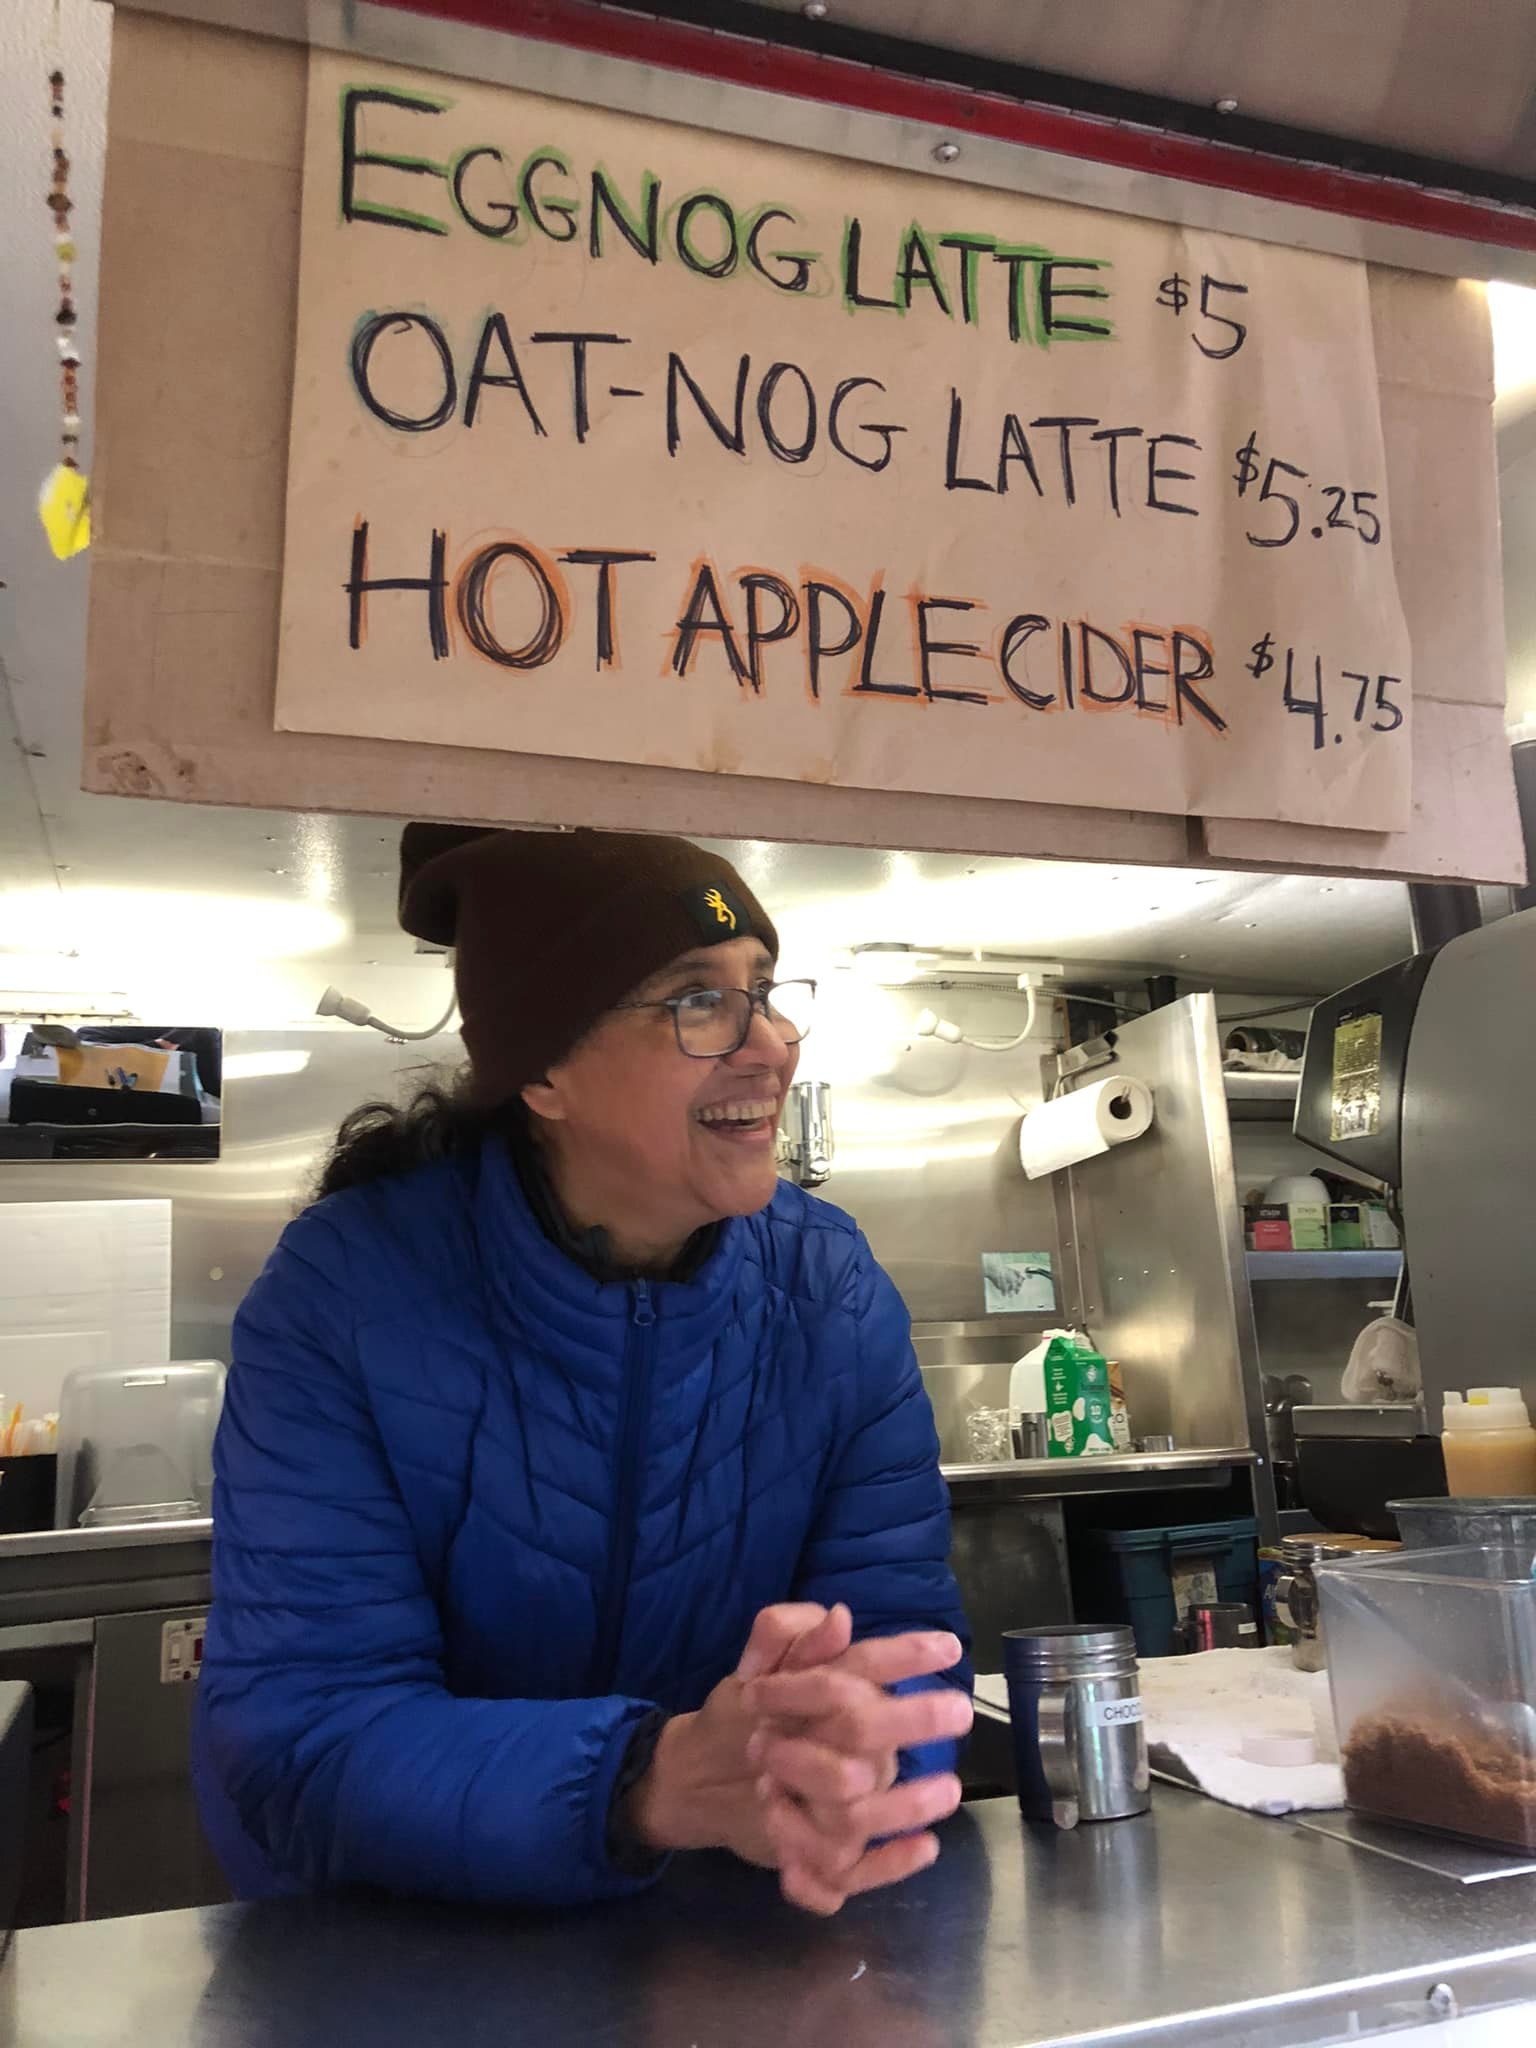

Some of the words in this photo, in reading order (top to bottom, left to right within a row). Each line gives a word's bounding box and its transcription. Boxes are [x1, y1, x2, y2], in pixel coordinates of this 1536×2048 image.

[341, 86, 824, 292] EGGNOG
[843, 216, 1113, 345] LATTE
[1156, 271, 1250, 360] $5
[351, 310, 908, 473] OAT-NOG
[944, 386, 1203, 518] LATTE
[1231, 430, 1381, 548] $5.25
[341, 518, 658, 674] HOT
[664, 558, 996, 706] APPLE
[998, 611, 1230, 735] CIDER
[1243, 631, 1405, 750] $4.75
